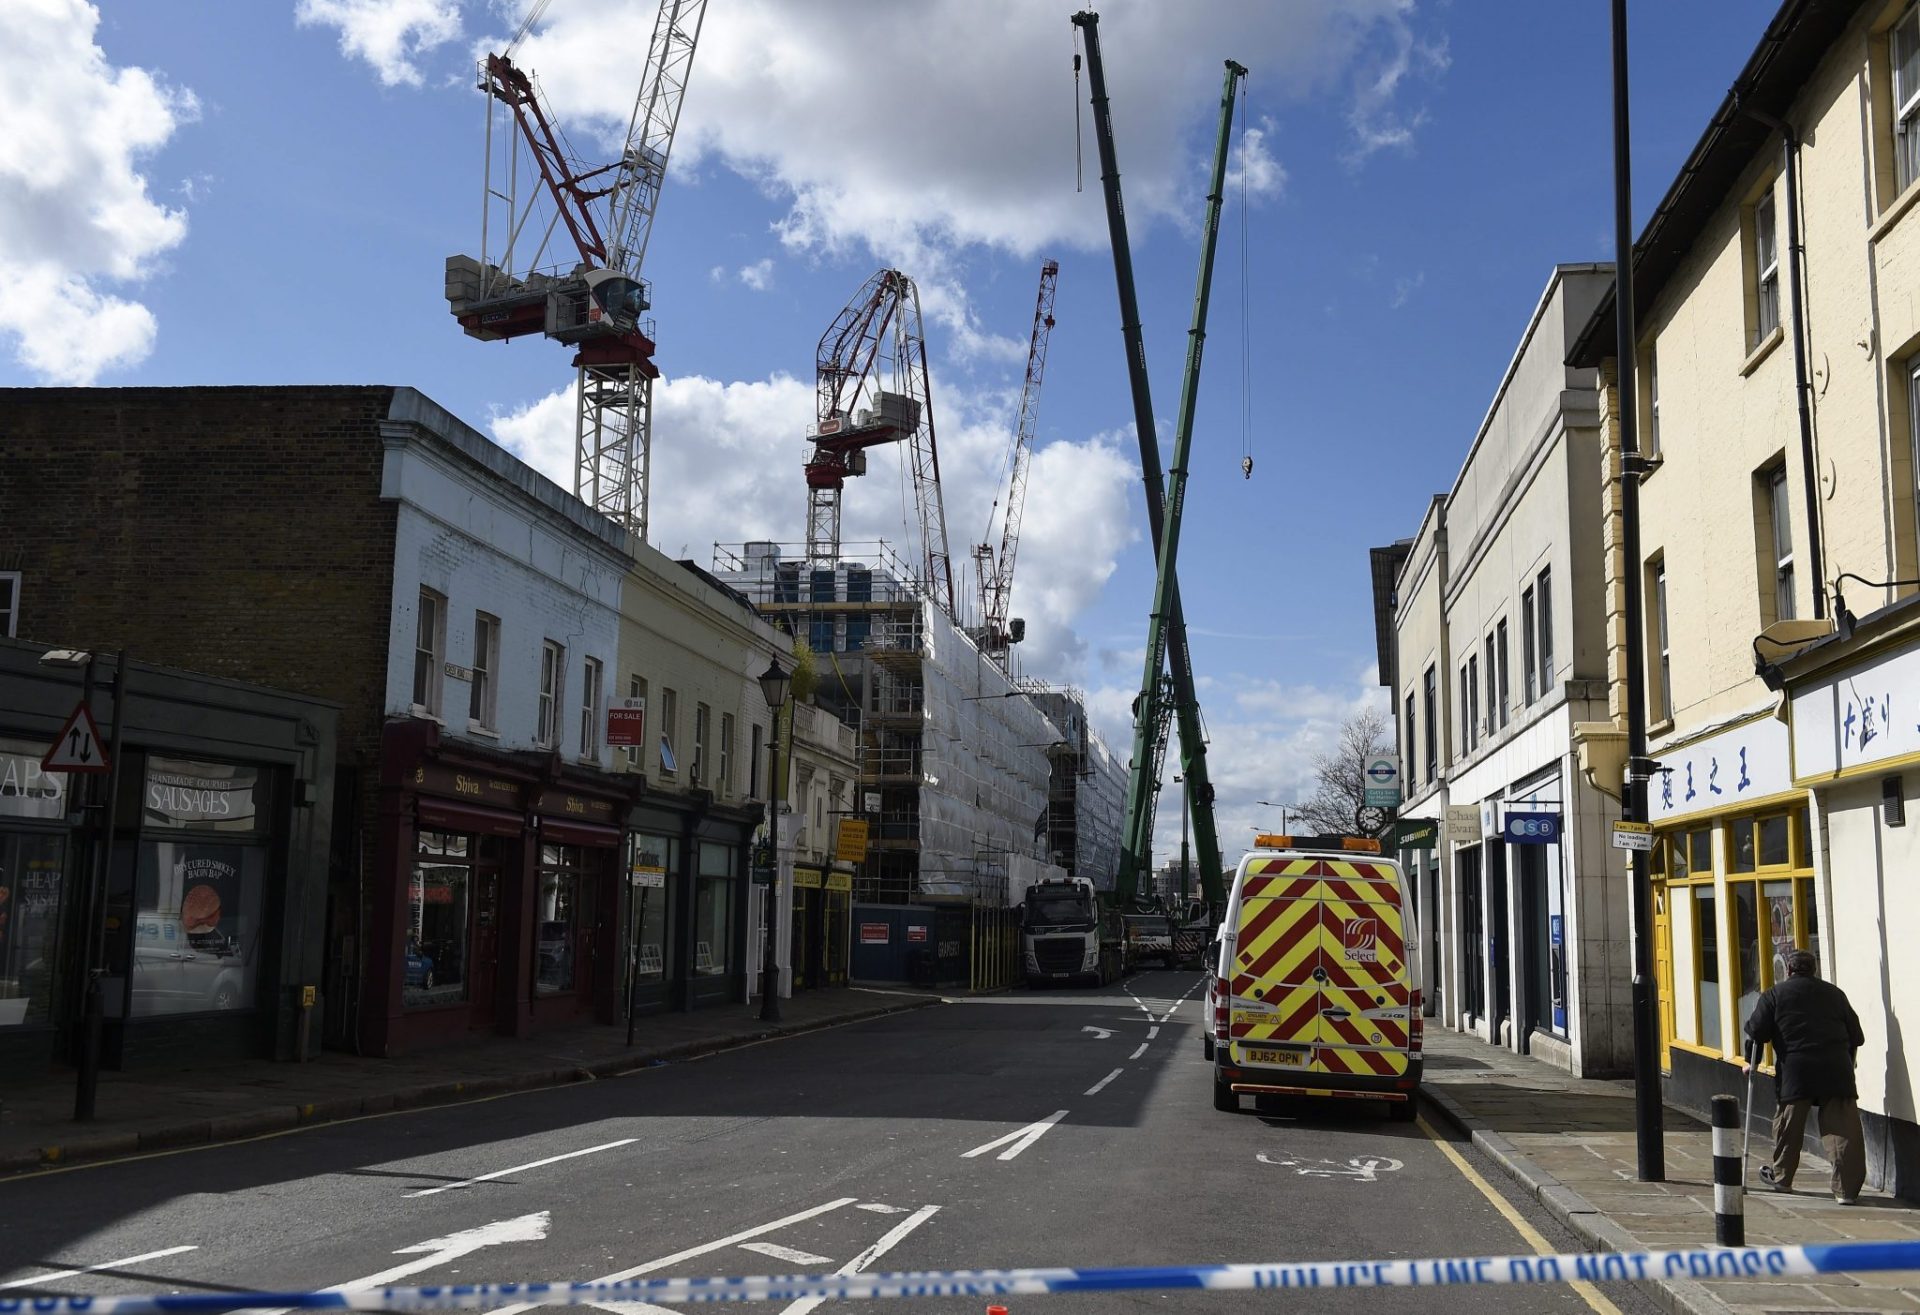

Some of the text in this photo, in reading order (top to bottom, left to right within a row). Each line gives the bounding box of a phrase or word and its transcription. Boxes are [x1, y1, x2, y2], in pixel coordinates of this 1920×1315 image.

[1174, 481, 1185, 517] EMERSON
[1156, 625, 1168, 668] EMERSON
[609, 712, 641, 721] FOR SALE
[0, 757, 62, 800] APS
[151, 773, 231, 790] HANDMADE GOURMET
[455, 774, 479, 795] Shiva
[149, 784, 230, 815] SAUSAGES
[566, 796, 584, 814] Shiva
[1399, 827, 1432, 845] SUBWAY
[1627, 834, 1647, 842] loading
[1344, 949, 1376, 961] Select
[1250, 1050, 1299, 1064] BJ62 OPN
[1409, 1260, 1494, 1286] LINE
[1508, 1258, 1562, 1283] DO
[1575, 1253, 1651, 1281] NOT
[1664, 1249, 1786, 1278] CROSS
